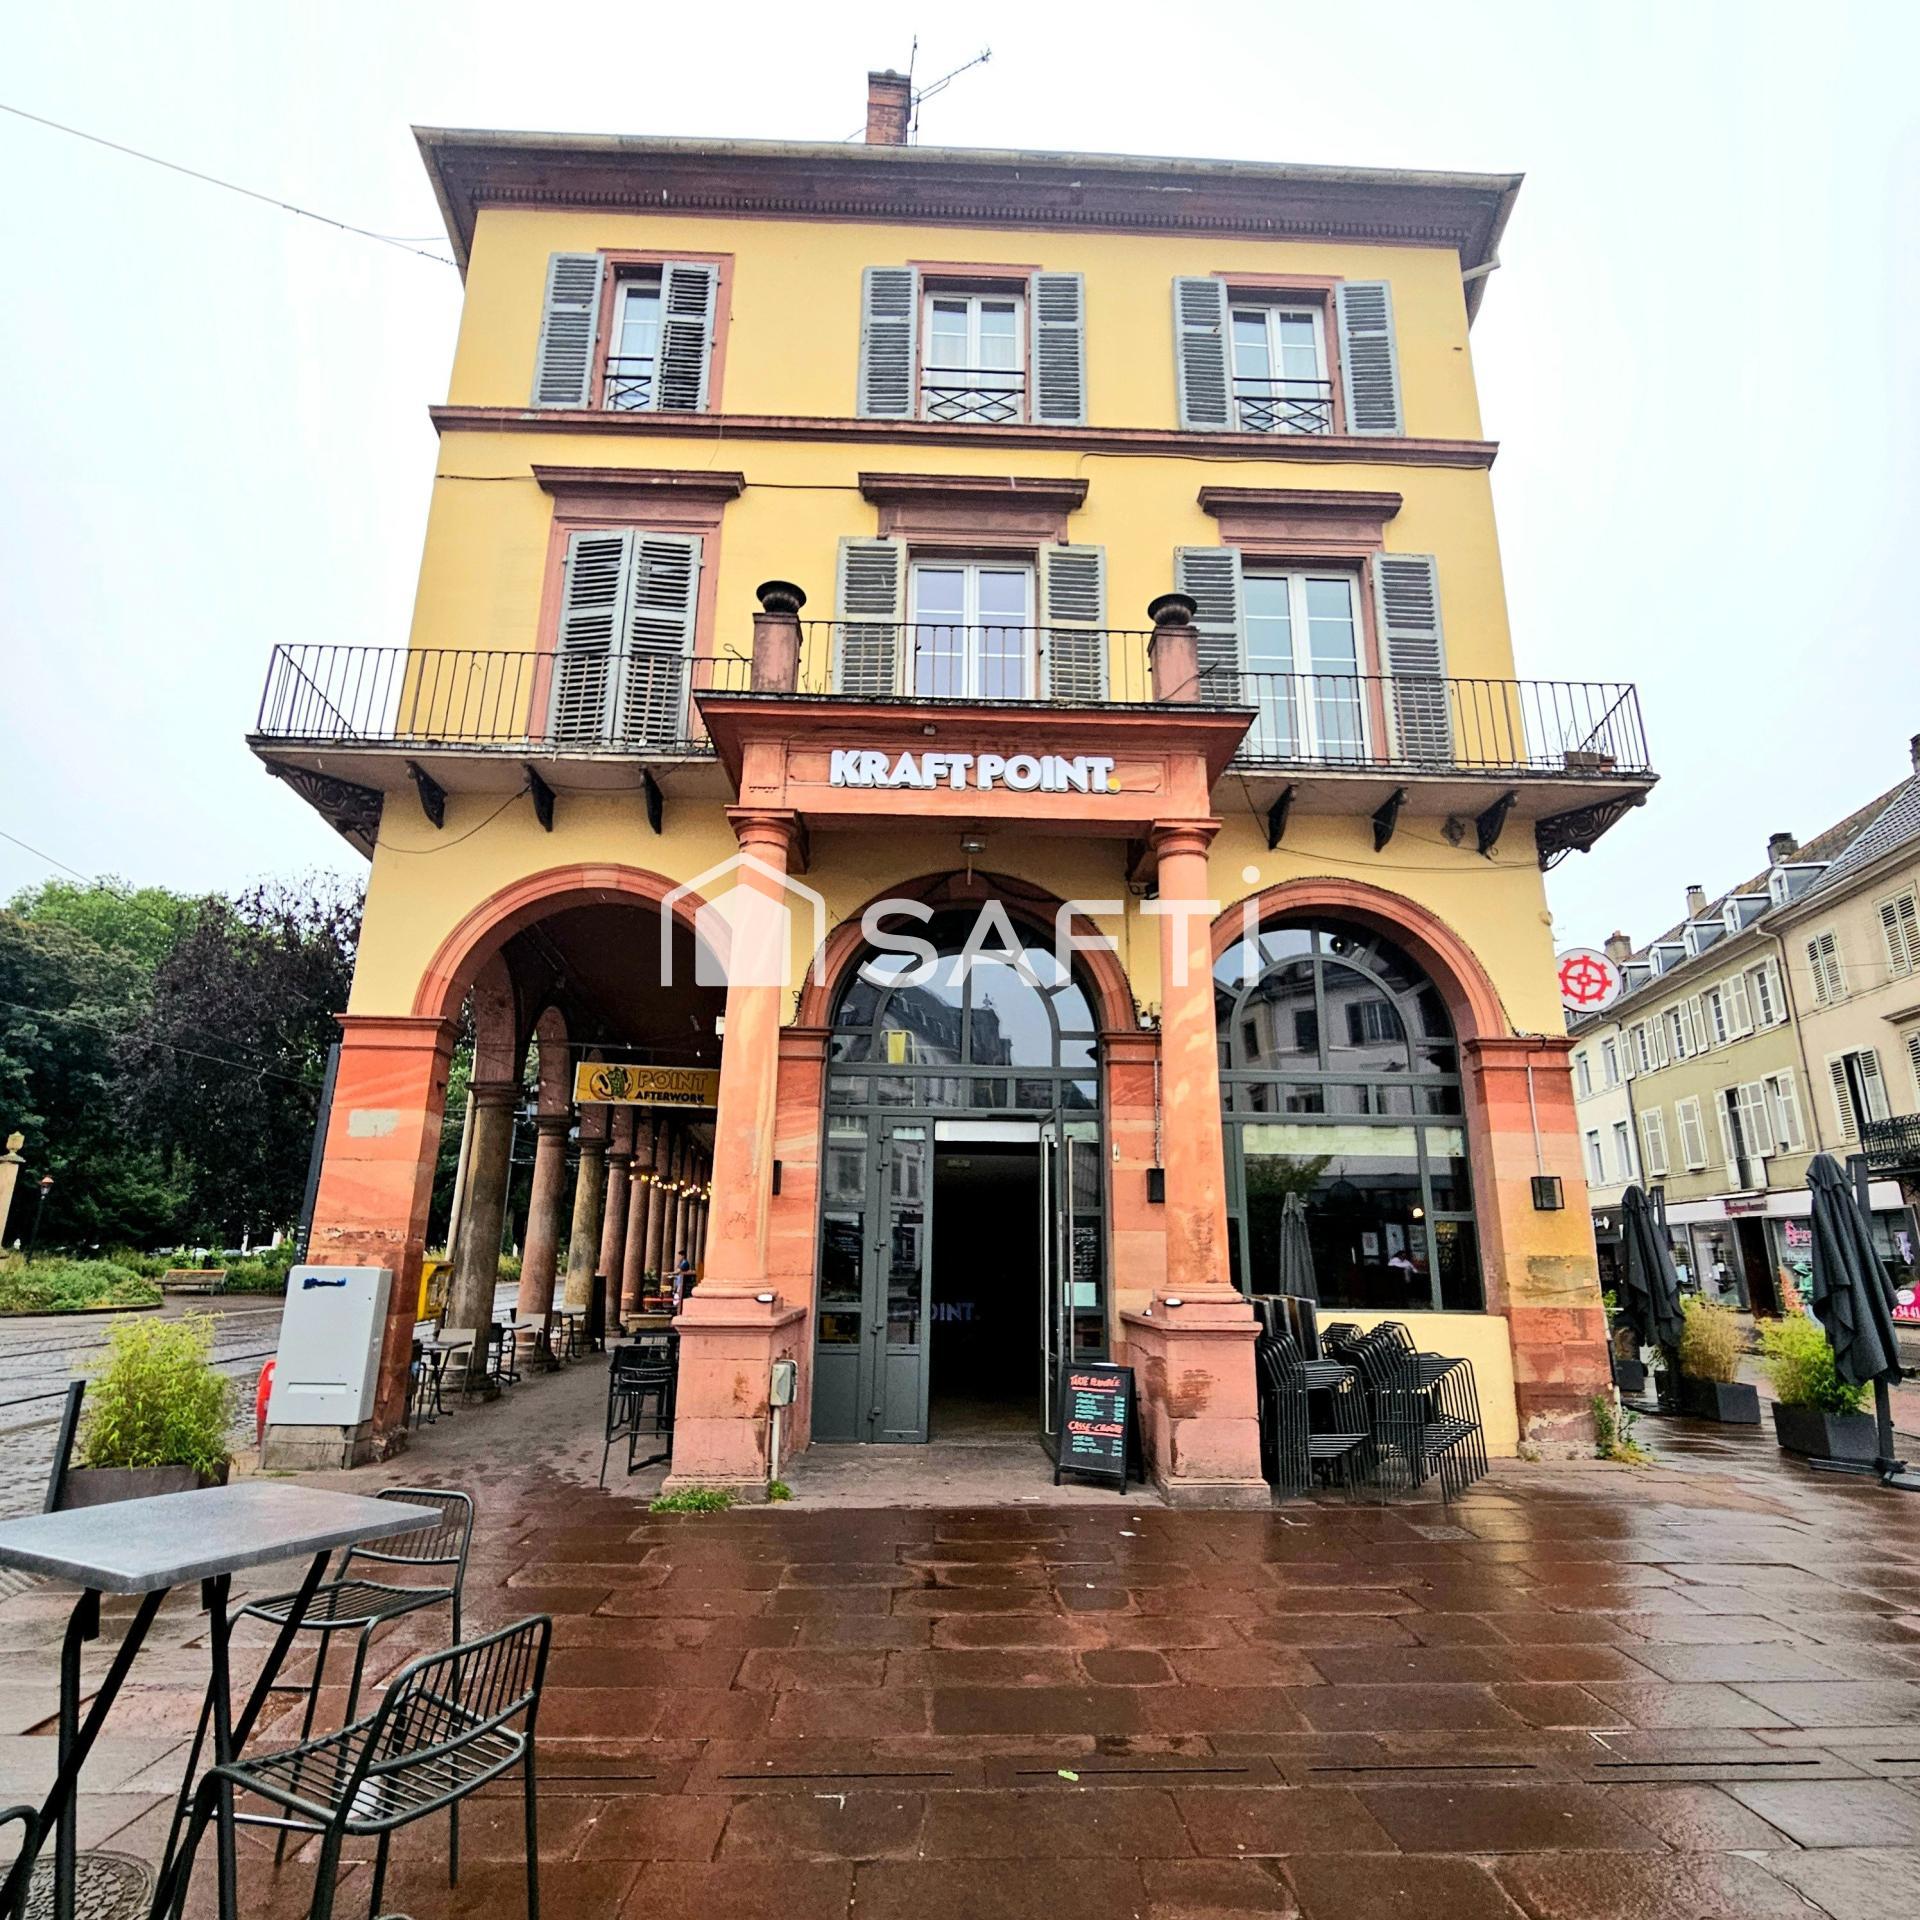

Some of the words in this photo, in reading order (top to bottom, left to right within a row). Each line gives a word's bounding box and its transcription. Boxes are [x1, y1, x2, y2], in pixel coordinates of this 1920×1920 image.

[830, 749, 974, 791] KRAFT
[638, 1070, 708, 1092] POINT
[635, 1090, 705, 1103] AFTERWORK
